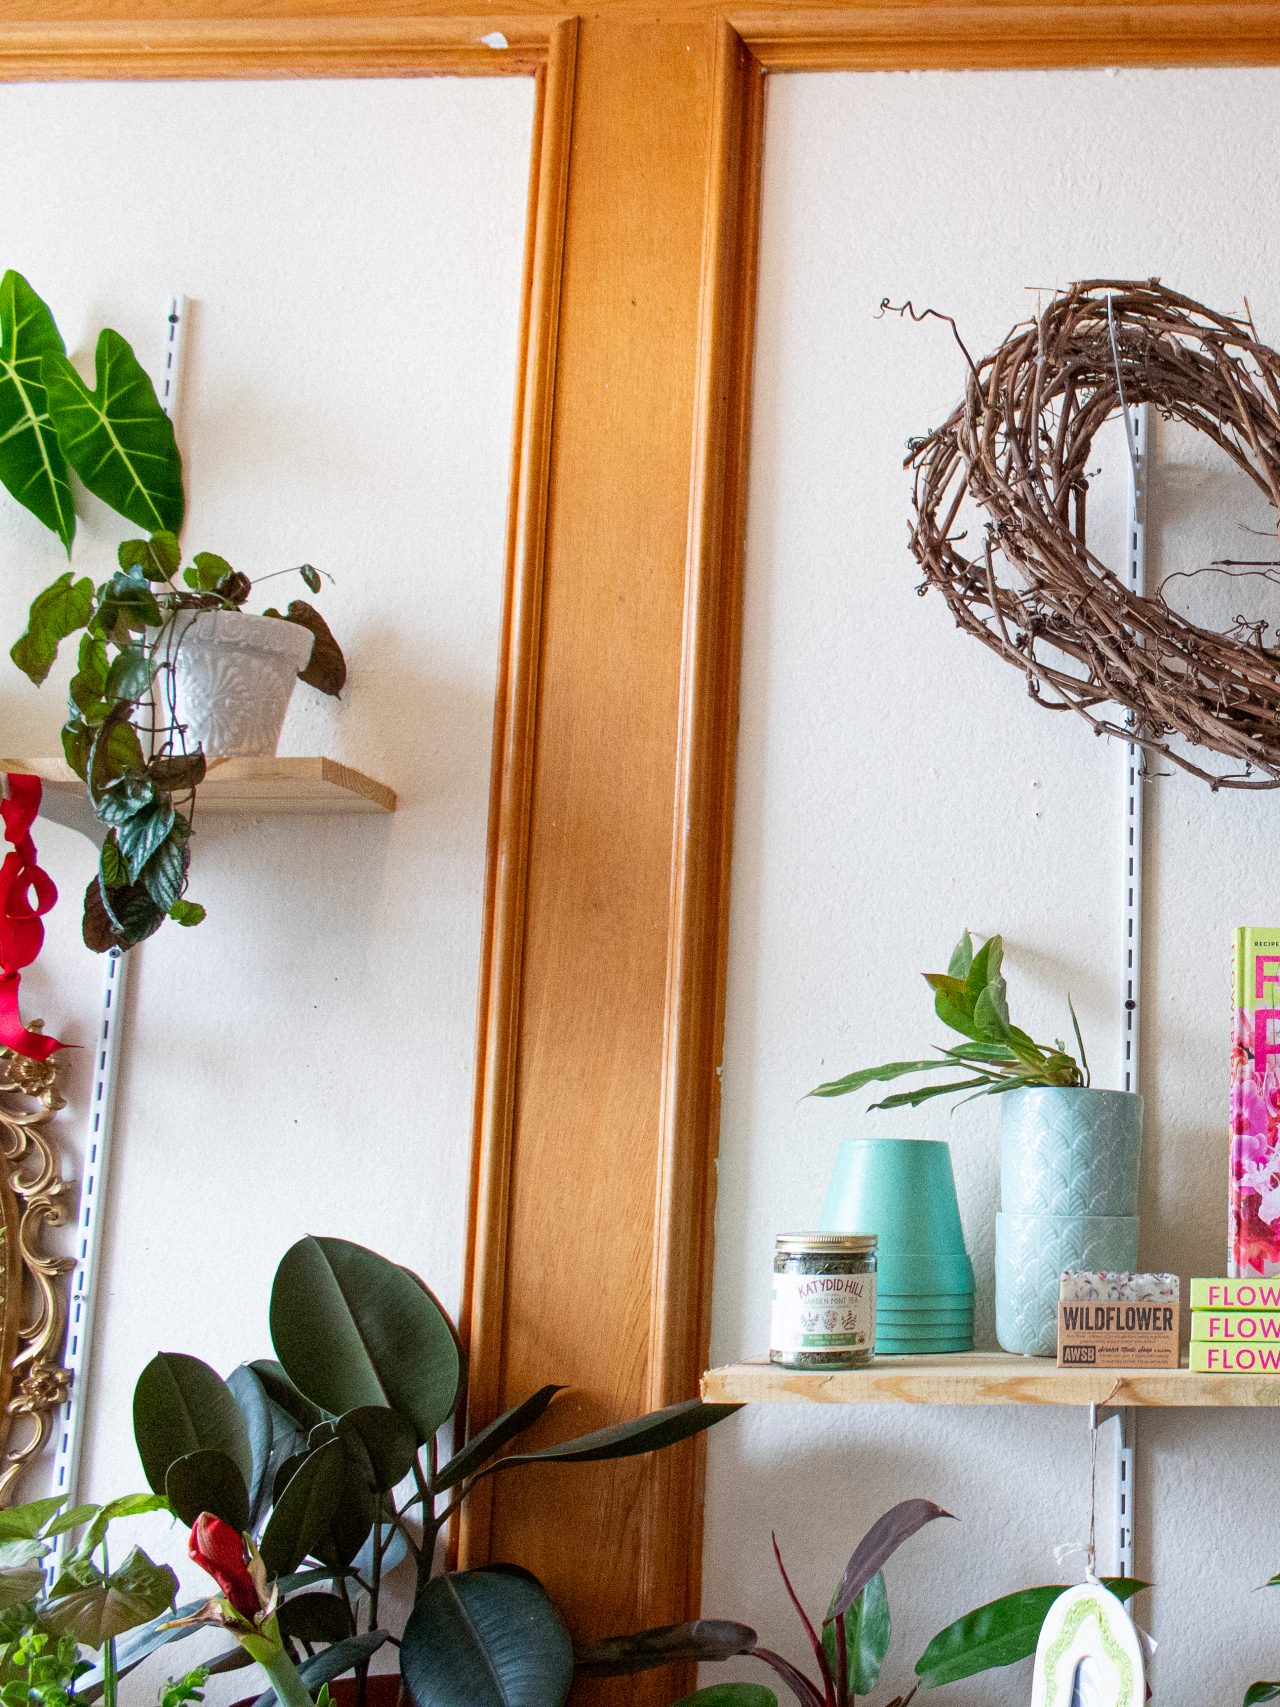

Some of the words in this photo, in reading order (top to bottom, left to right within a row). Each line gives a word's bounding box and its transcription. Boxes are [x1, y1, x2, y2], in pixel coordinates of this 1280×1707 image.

[798, 1279, 844, 1299] KATYDID
[845, 1280, 864, 1298] HILL
[1063, 1307, 1173, 1331] WILDFLOWER
[1064, 1348, 1095, 1362] AWSB
